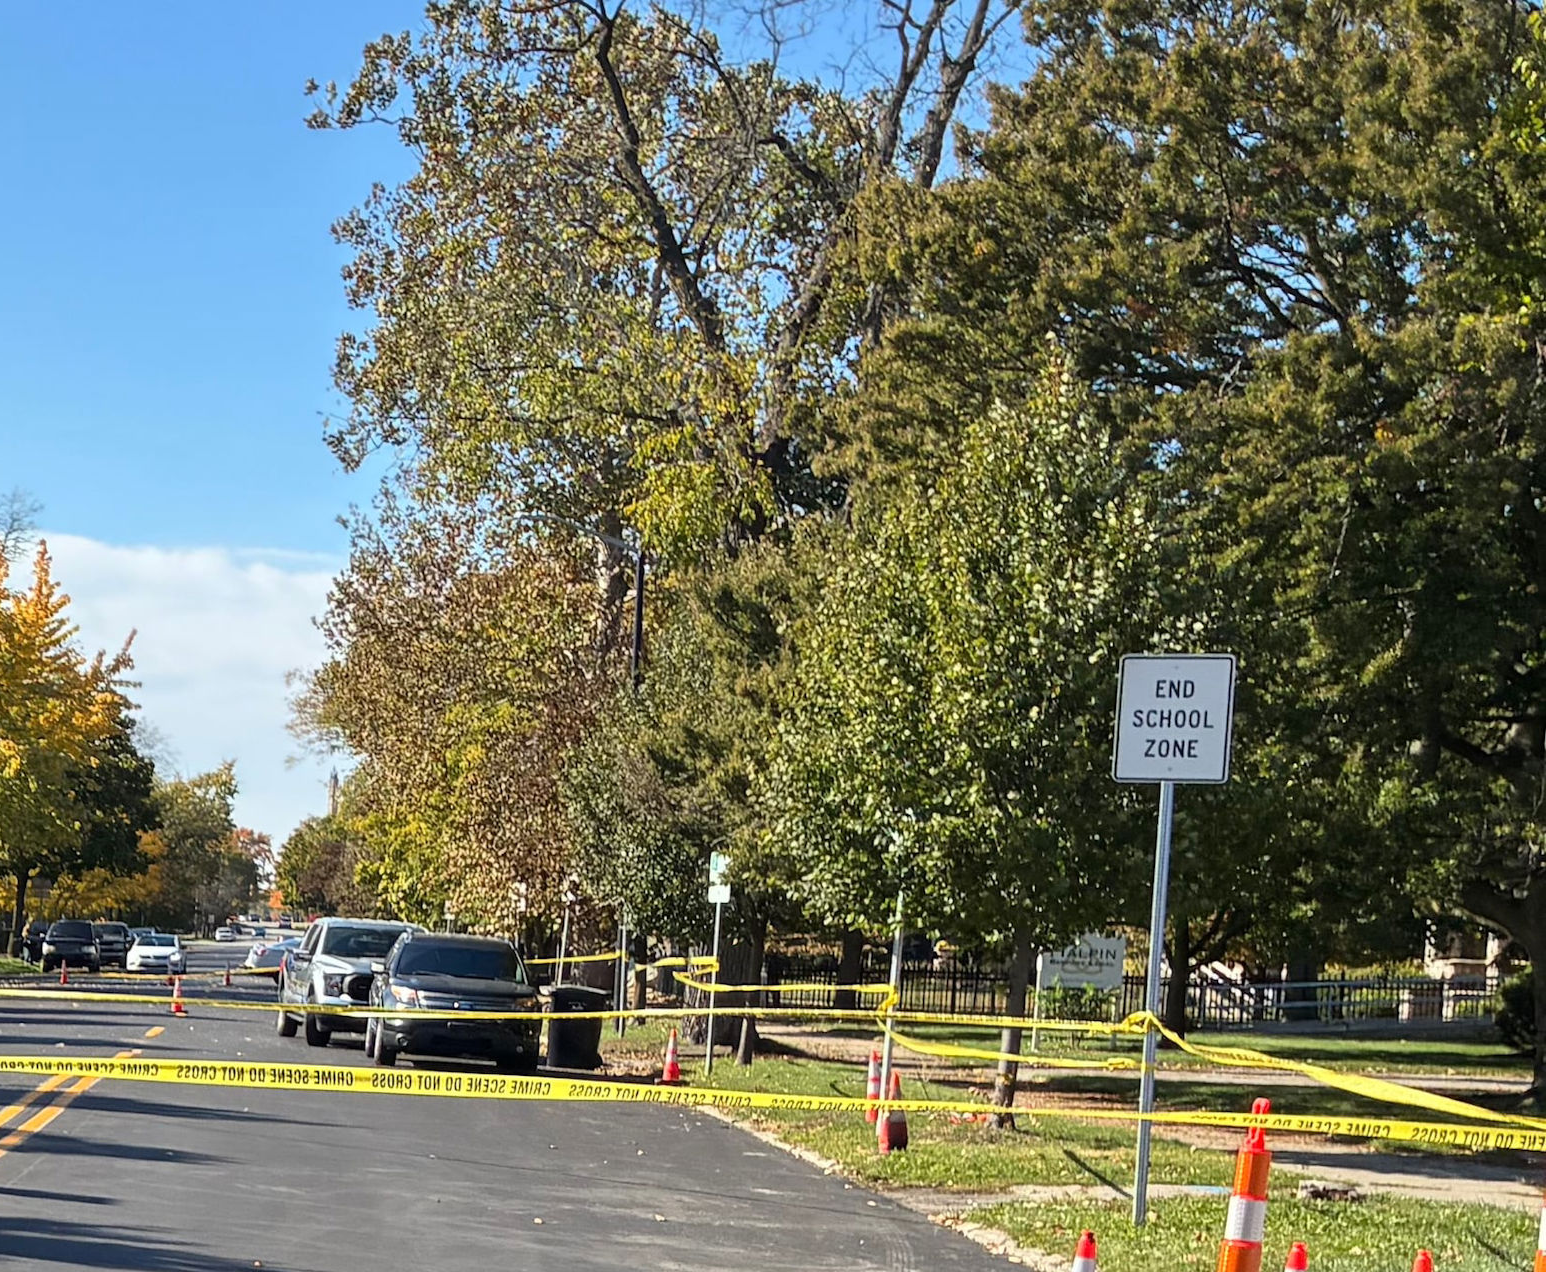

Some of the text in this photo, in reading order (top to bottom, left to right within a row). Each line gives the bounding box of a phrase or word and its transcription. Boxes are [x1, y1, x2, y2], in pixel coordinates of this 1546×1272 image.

[1156, 680, 1195, 698] END
[1133, 709, 1214, 729] SCHOOL
[1144, 739, 1198, 758] ZONE
